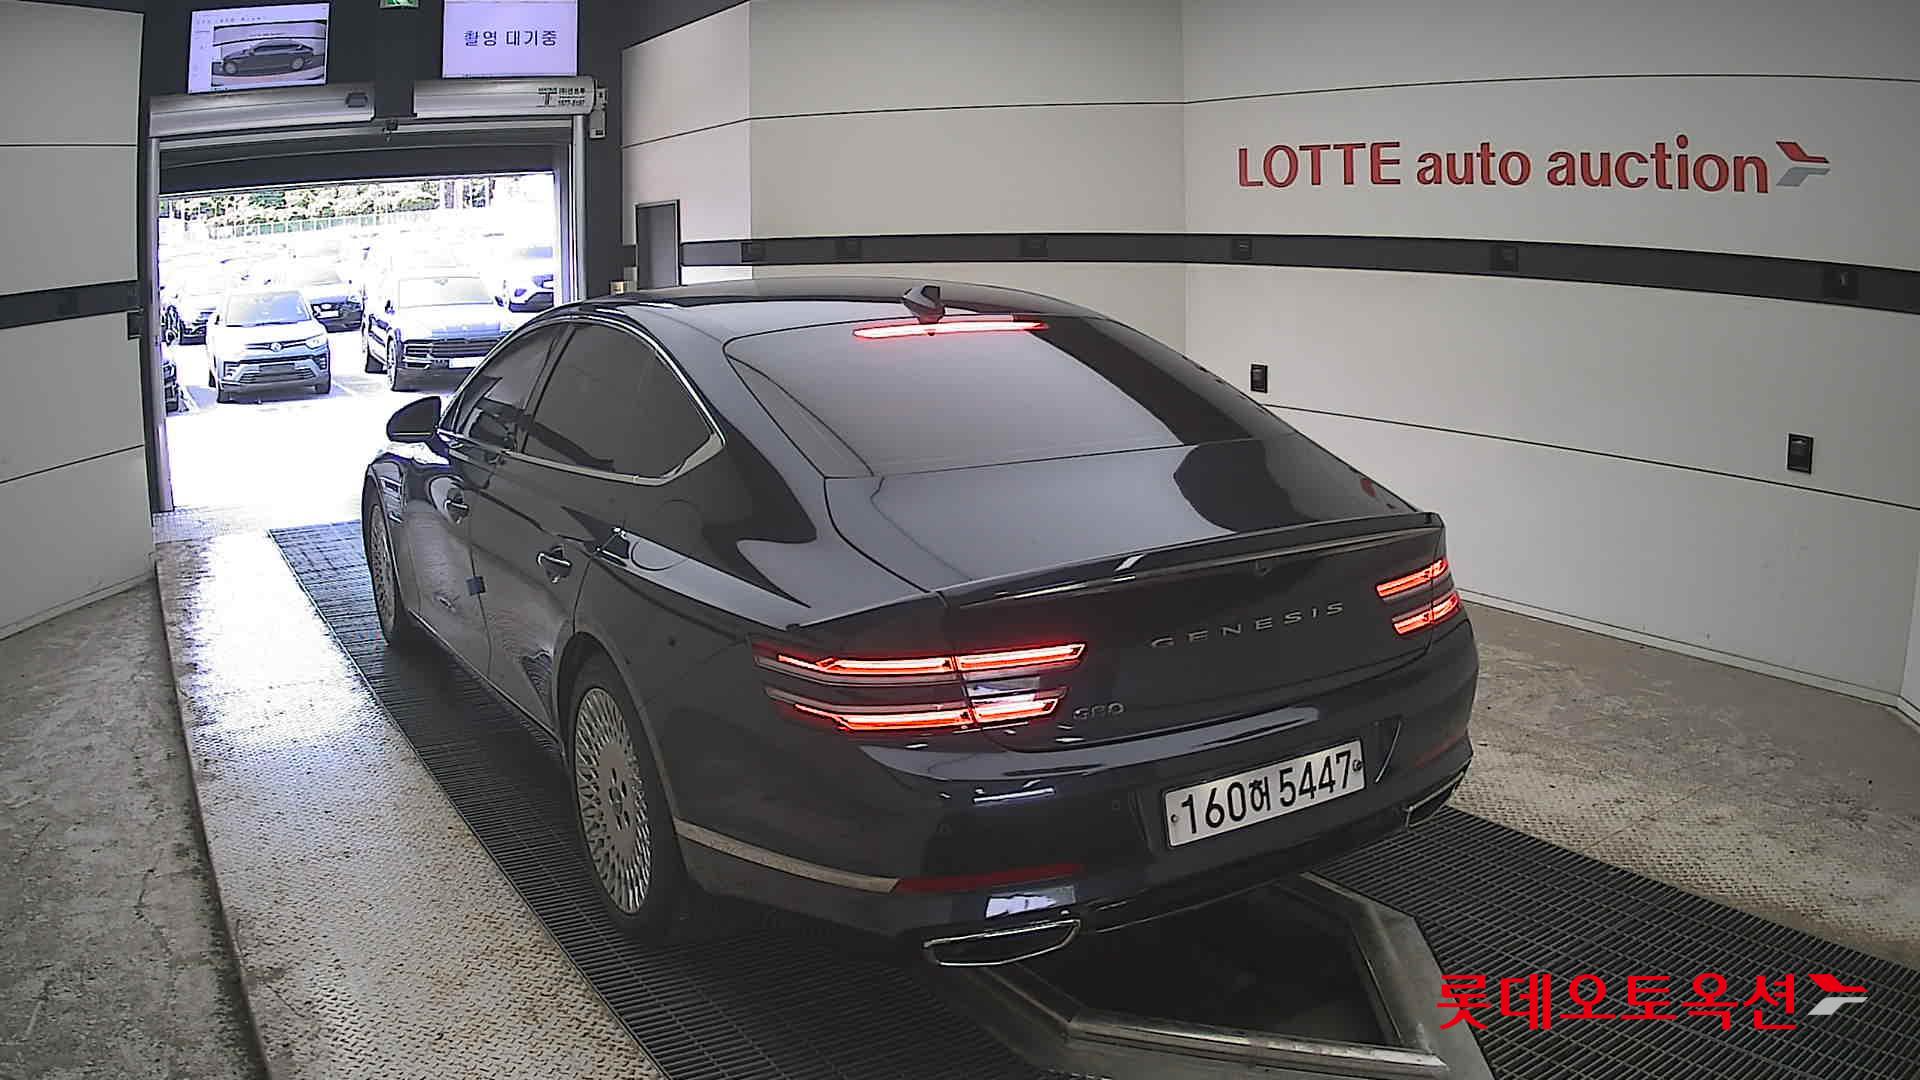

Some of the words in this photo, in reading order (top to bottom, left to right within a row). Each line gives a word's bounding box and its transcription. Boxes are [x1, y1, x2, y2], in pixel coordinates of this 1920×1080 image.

[464, 30, 497, 46] 촬영
[506, 30, 557, 46] 대기중
[1238, 141, 1401, 187] LOTTE
[1417, 141, 1531, 186] auto
[1547, 135, 1769, 194] auction
[1151, 602, 1344, 647] GENESIS
[1181, 776, 1271, 834] 160허
[1279, 750, 1351, 807] 5447
